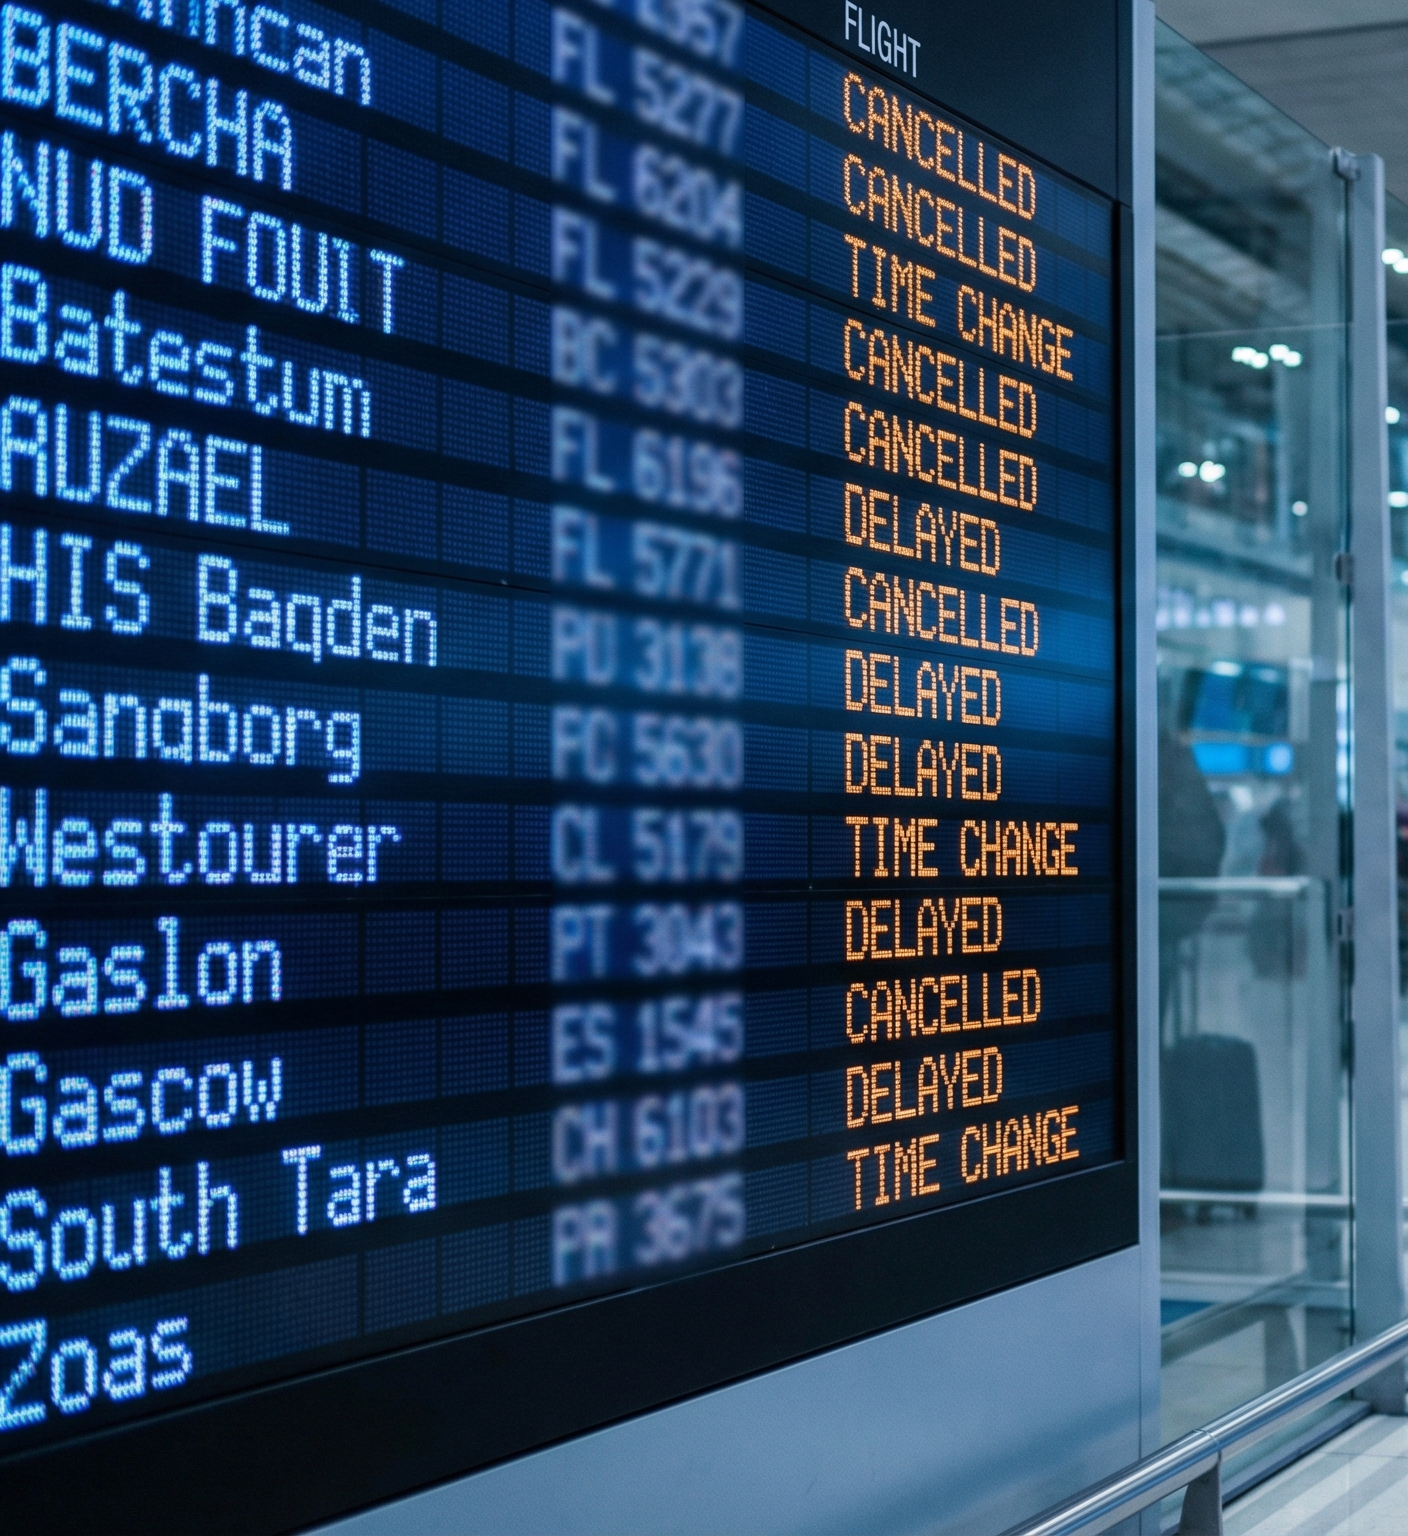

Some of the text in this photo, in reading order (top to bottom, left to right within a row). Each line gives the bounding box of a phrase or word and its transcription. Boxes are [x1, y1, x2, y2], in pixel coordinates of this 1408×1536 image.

[551, 6, 616, 104] FL
[845, 0, 922, 78] FLIGHT
[0, 4, 293, 191] BERCHA
[843, 72, 1037, 221] CANCELLED
[0, 131, 153, 264] NUD
[551, 106, 616, 203] FL
[551, 204, 617, 299] FL
[843, 152, 1037, 294] CANCELLED
[0, 263, 372, 438] Batestum
[843, 233, 1075, 382] TIME CHANGE
[843, 317, 1038, 439] CANCELLED
[551, 406, 616, 493] FL
[843, 400, 1038, 512] CANCELLED
[0, 524, 151, 635] HIS
[551, 504, 614, 589] FL
[843, 481, 1001, 577] DELAYED
[843, 565, 1040, 657] CANCELLED
[843, 648, 1001, 727] DELAYED
[844, 731, 1003, 802] DELAYED
[0, 786, 402, 888] Westourer
[844, 815, 1080, 878] TIME CHANGE
[0, 915, 283, 1020] Gaslon
[845, 895, 1003, 962] DELAYED
[845, 967, 1042, 1045] CANCELLED
[0, 1052, 283, 1154] Gascow
[845, 1045, 1004, 1130] DELAYED
[845, 1104, 1081, 1211] TIME CHANGE
[0, 1144, 437, 1292] South Tara
[0, 1317, 193, 1429] Zoas
